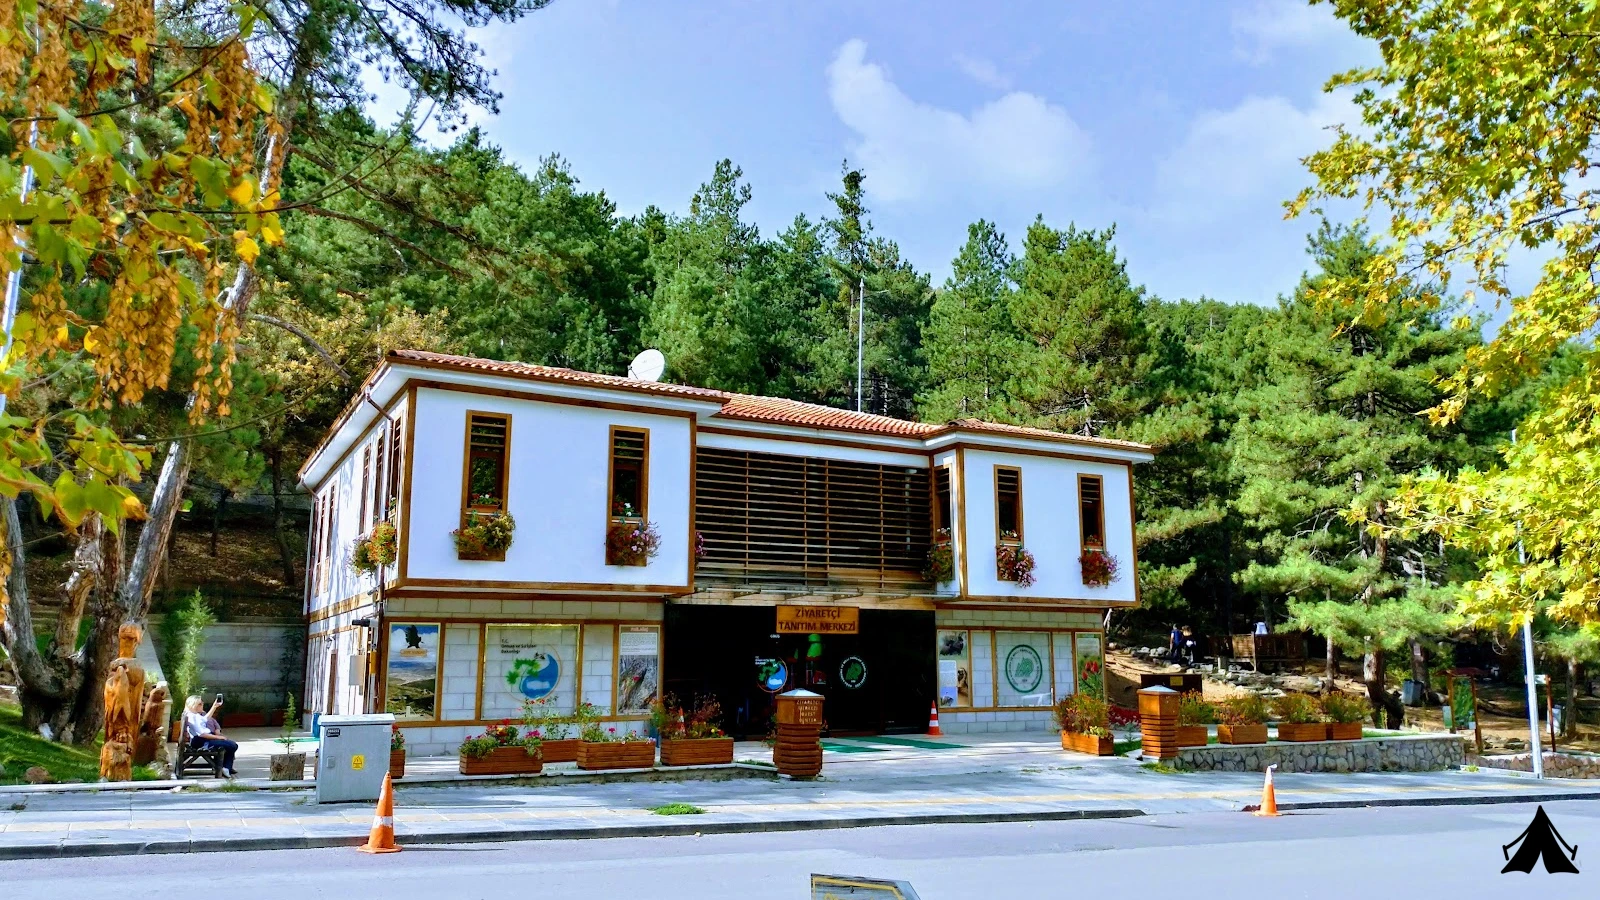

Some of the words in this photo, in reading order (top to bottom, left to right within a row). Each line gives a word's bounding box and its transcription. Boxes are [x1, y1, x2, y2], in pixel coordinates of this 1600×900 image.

[795, 607, 841, 619] ZİYARETÇİ
[778, 621, 817, 631] TANITIM
[820, 621, 856, 631] MERKEZİ
